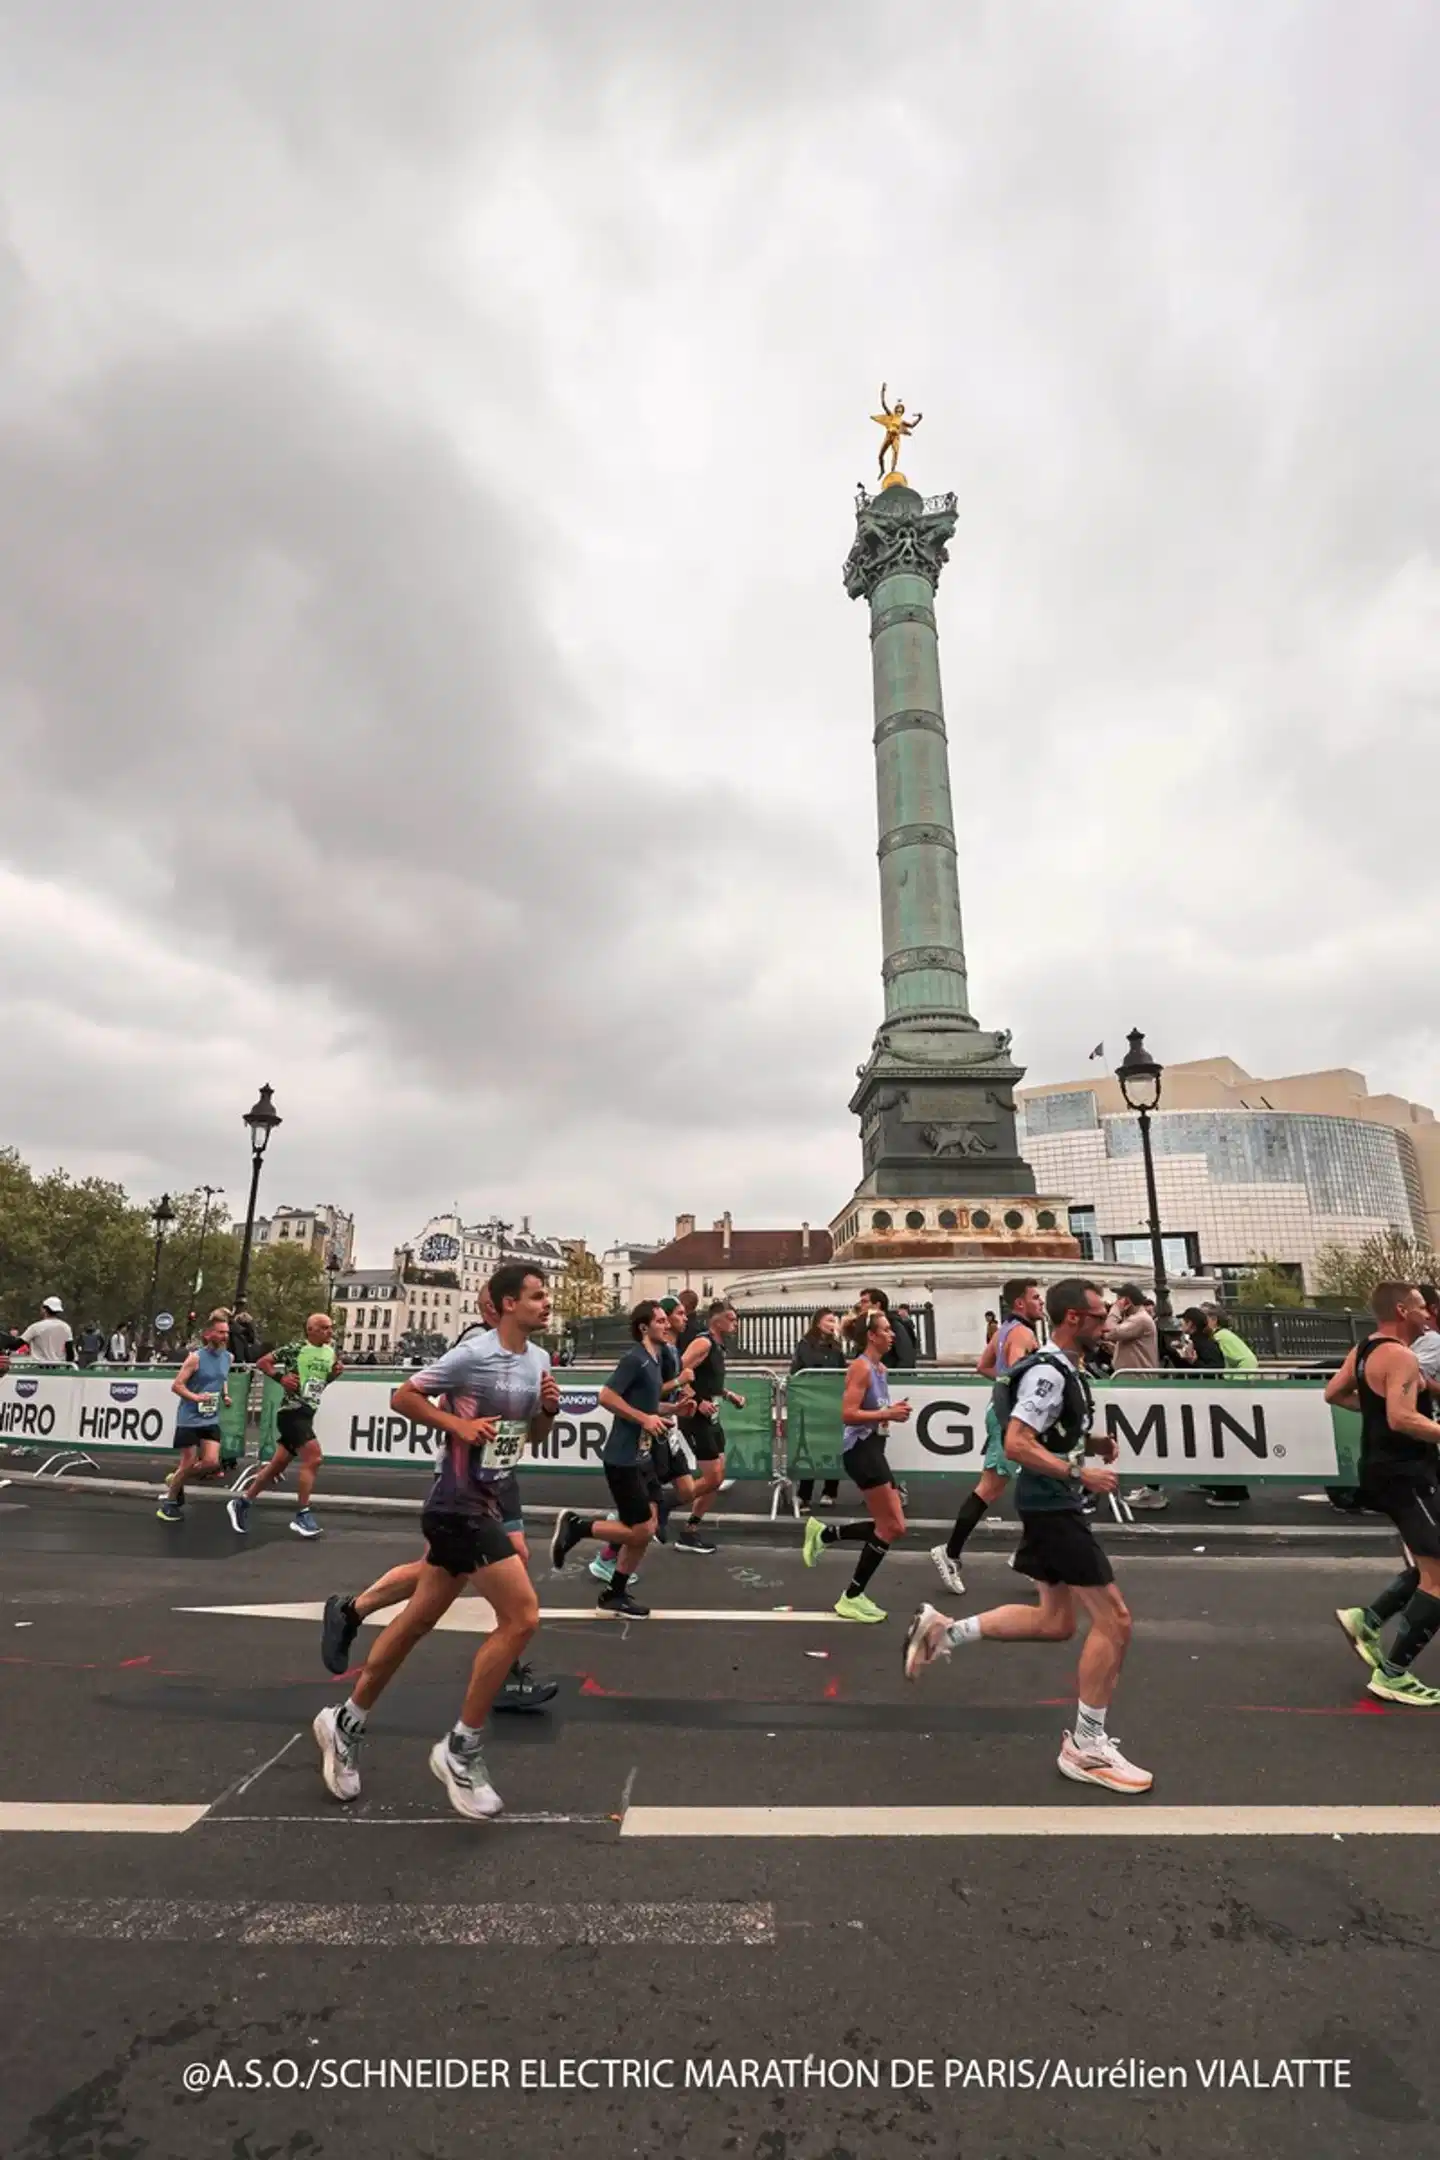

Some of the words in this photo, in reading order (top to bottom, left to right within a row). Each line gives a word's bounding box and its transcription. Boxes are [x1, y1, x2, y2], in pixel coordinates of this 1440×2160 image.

[79, 1406, 163, 1442] HiPRO
[530, 1421, 608, 1461] iPR
[916, 1400, 1268, 1459] GMIN
